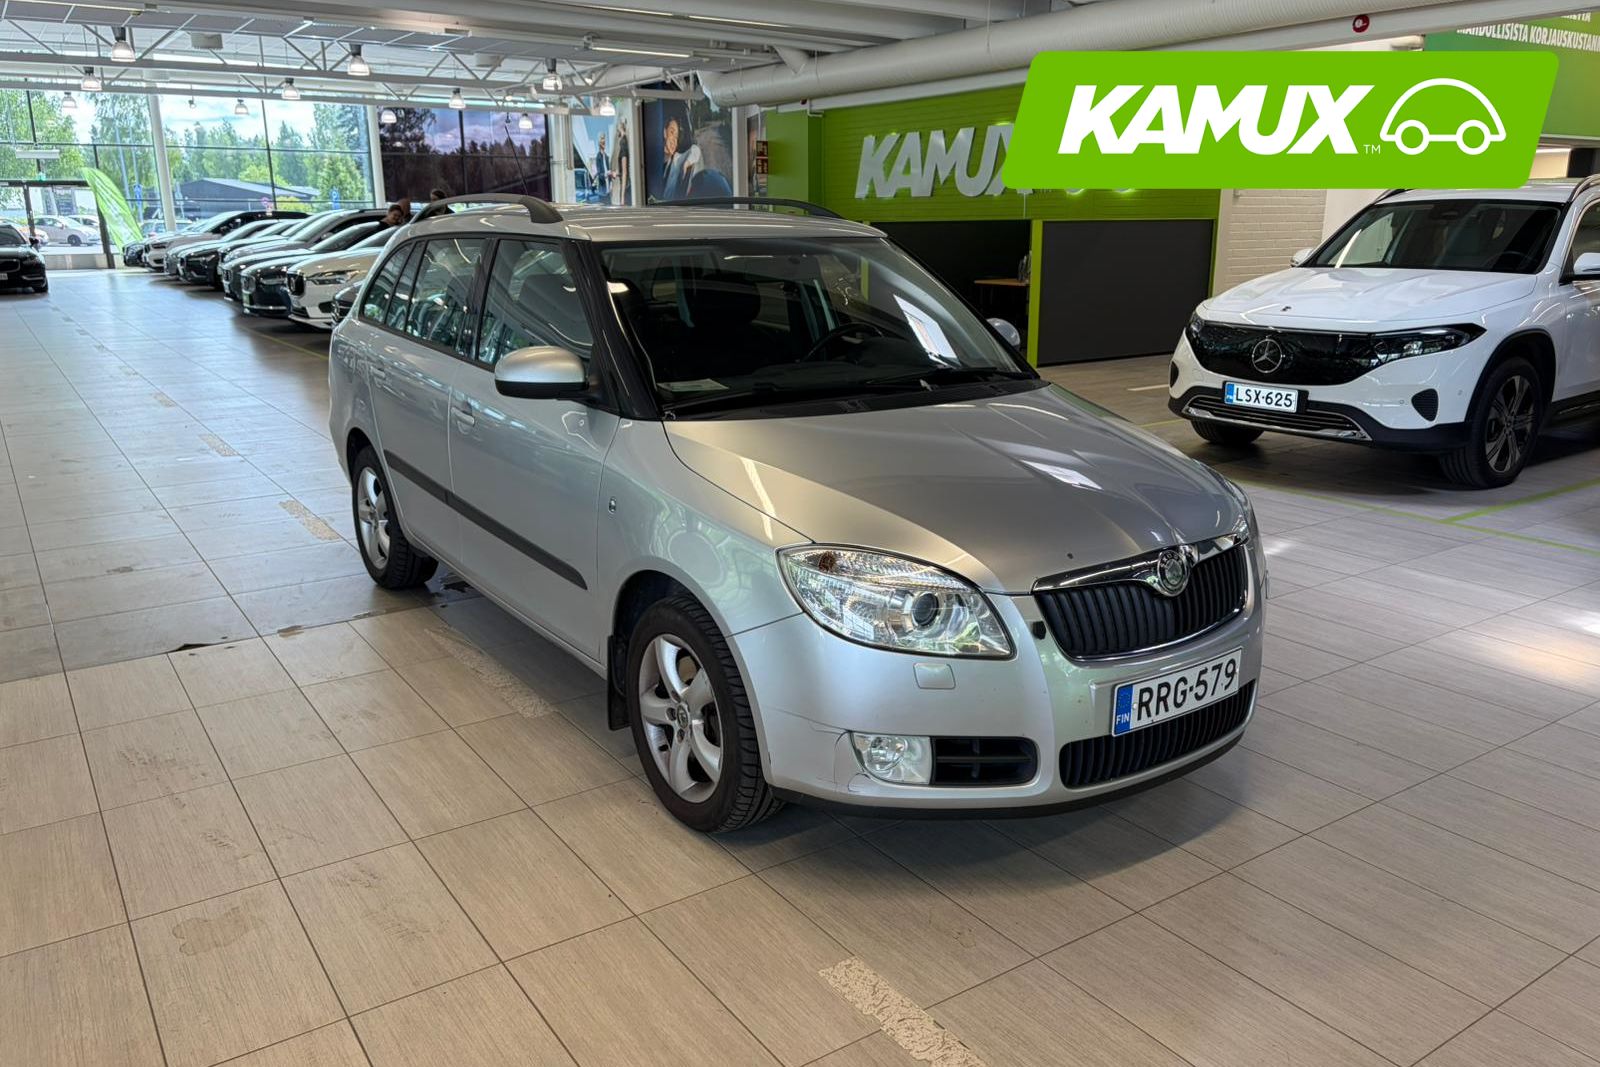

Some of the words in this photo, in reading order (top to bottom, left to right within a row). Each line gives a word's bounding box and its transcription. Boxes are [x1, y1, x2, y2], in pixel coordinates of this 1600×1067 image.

[1456, 23, 1529, 43] DOLLISISTA
[1235, 388, 1293, 408] LSX-625
[1116, 712, 1130, 725] FIN
[1137, 658, 1237, 721] RRG-579
